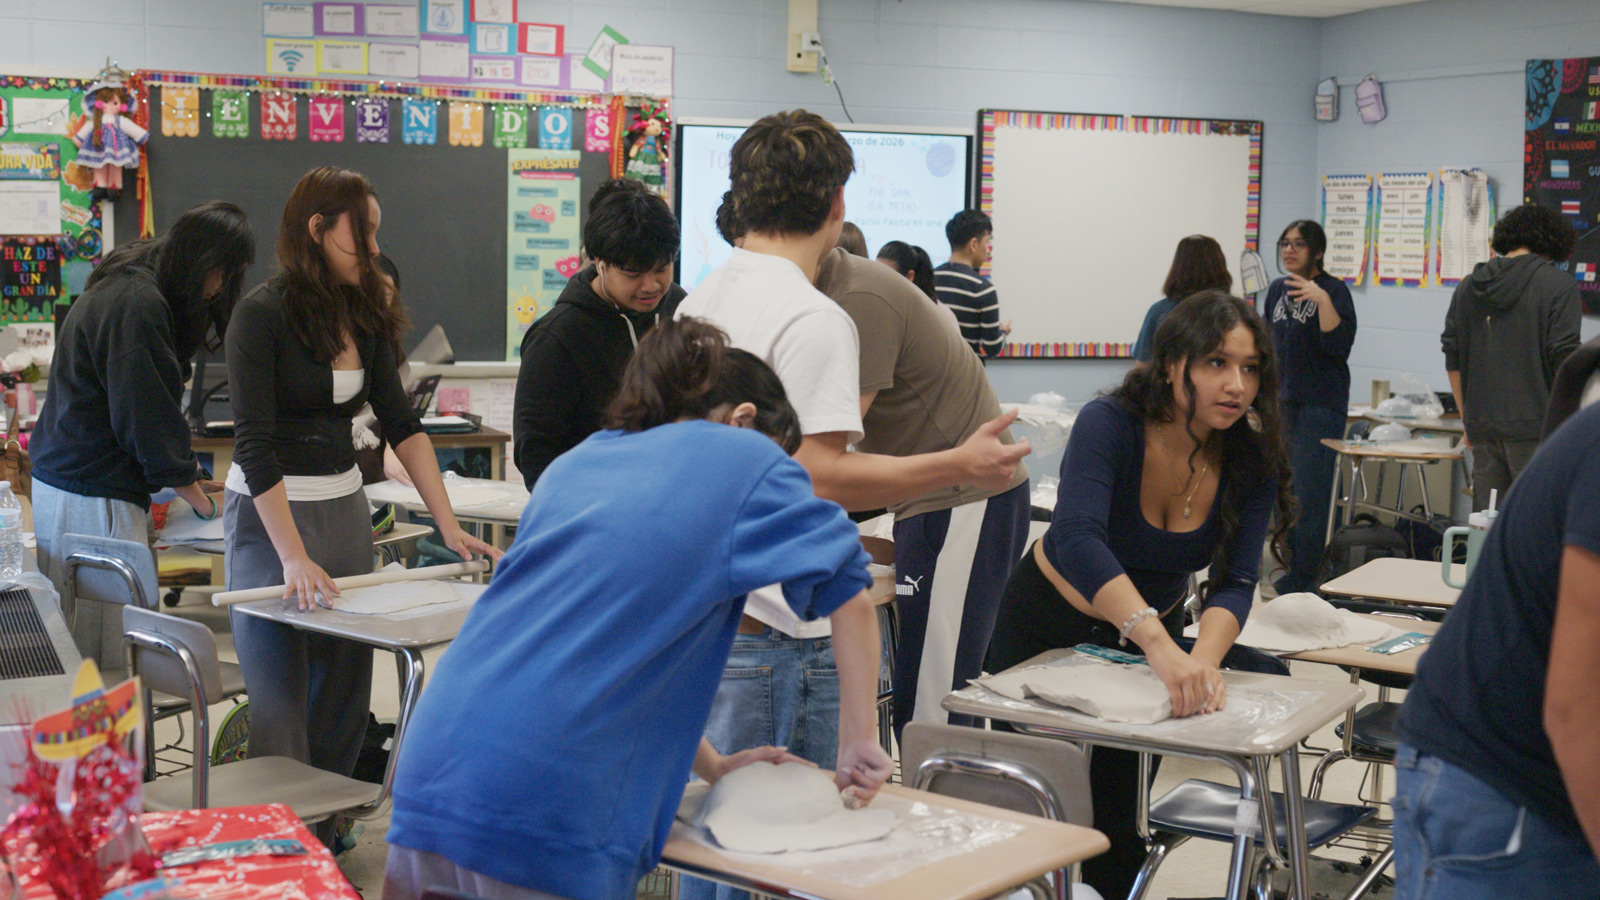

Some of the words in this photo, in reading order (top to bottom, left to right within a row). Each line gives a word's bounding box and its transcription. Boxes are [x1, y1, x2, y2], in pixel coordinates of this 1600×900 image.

[716, 131, 736, 142] Hoy
[865, 136, 878, 145] de
[879, 137, 905, 147] 2026
[1545, 141, 1556, 151] EL
[1558, 139, 1597, 151] SALVADOR
[24, 153, 54, 169] VIDA
[1540, 181, 1582, 191] HONDURAS
[883, 218, 923, 227] Features
[1334, 230, 1354, 238] jueves
[4, 247, 32, 260] HAZ
[36, 247, 55, 260] DE
[13, 261, 47, 272] ESTE
[19, 273, 41, 284] UN
[4, 285, 35, 296] GRAN
[37, 282, 57, 296] DÍA
[896, 584, 914, 596] UMA
